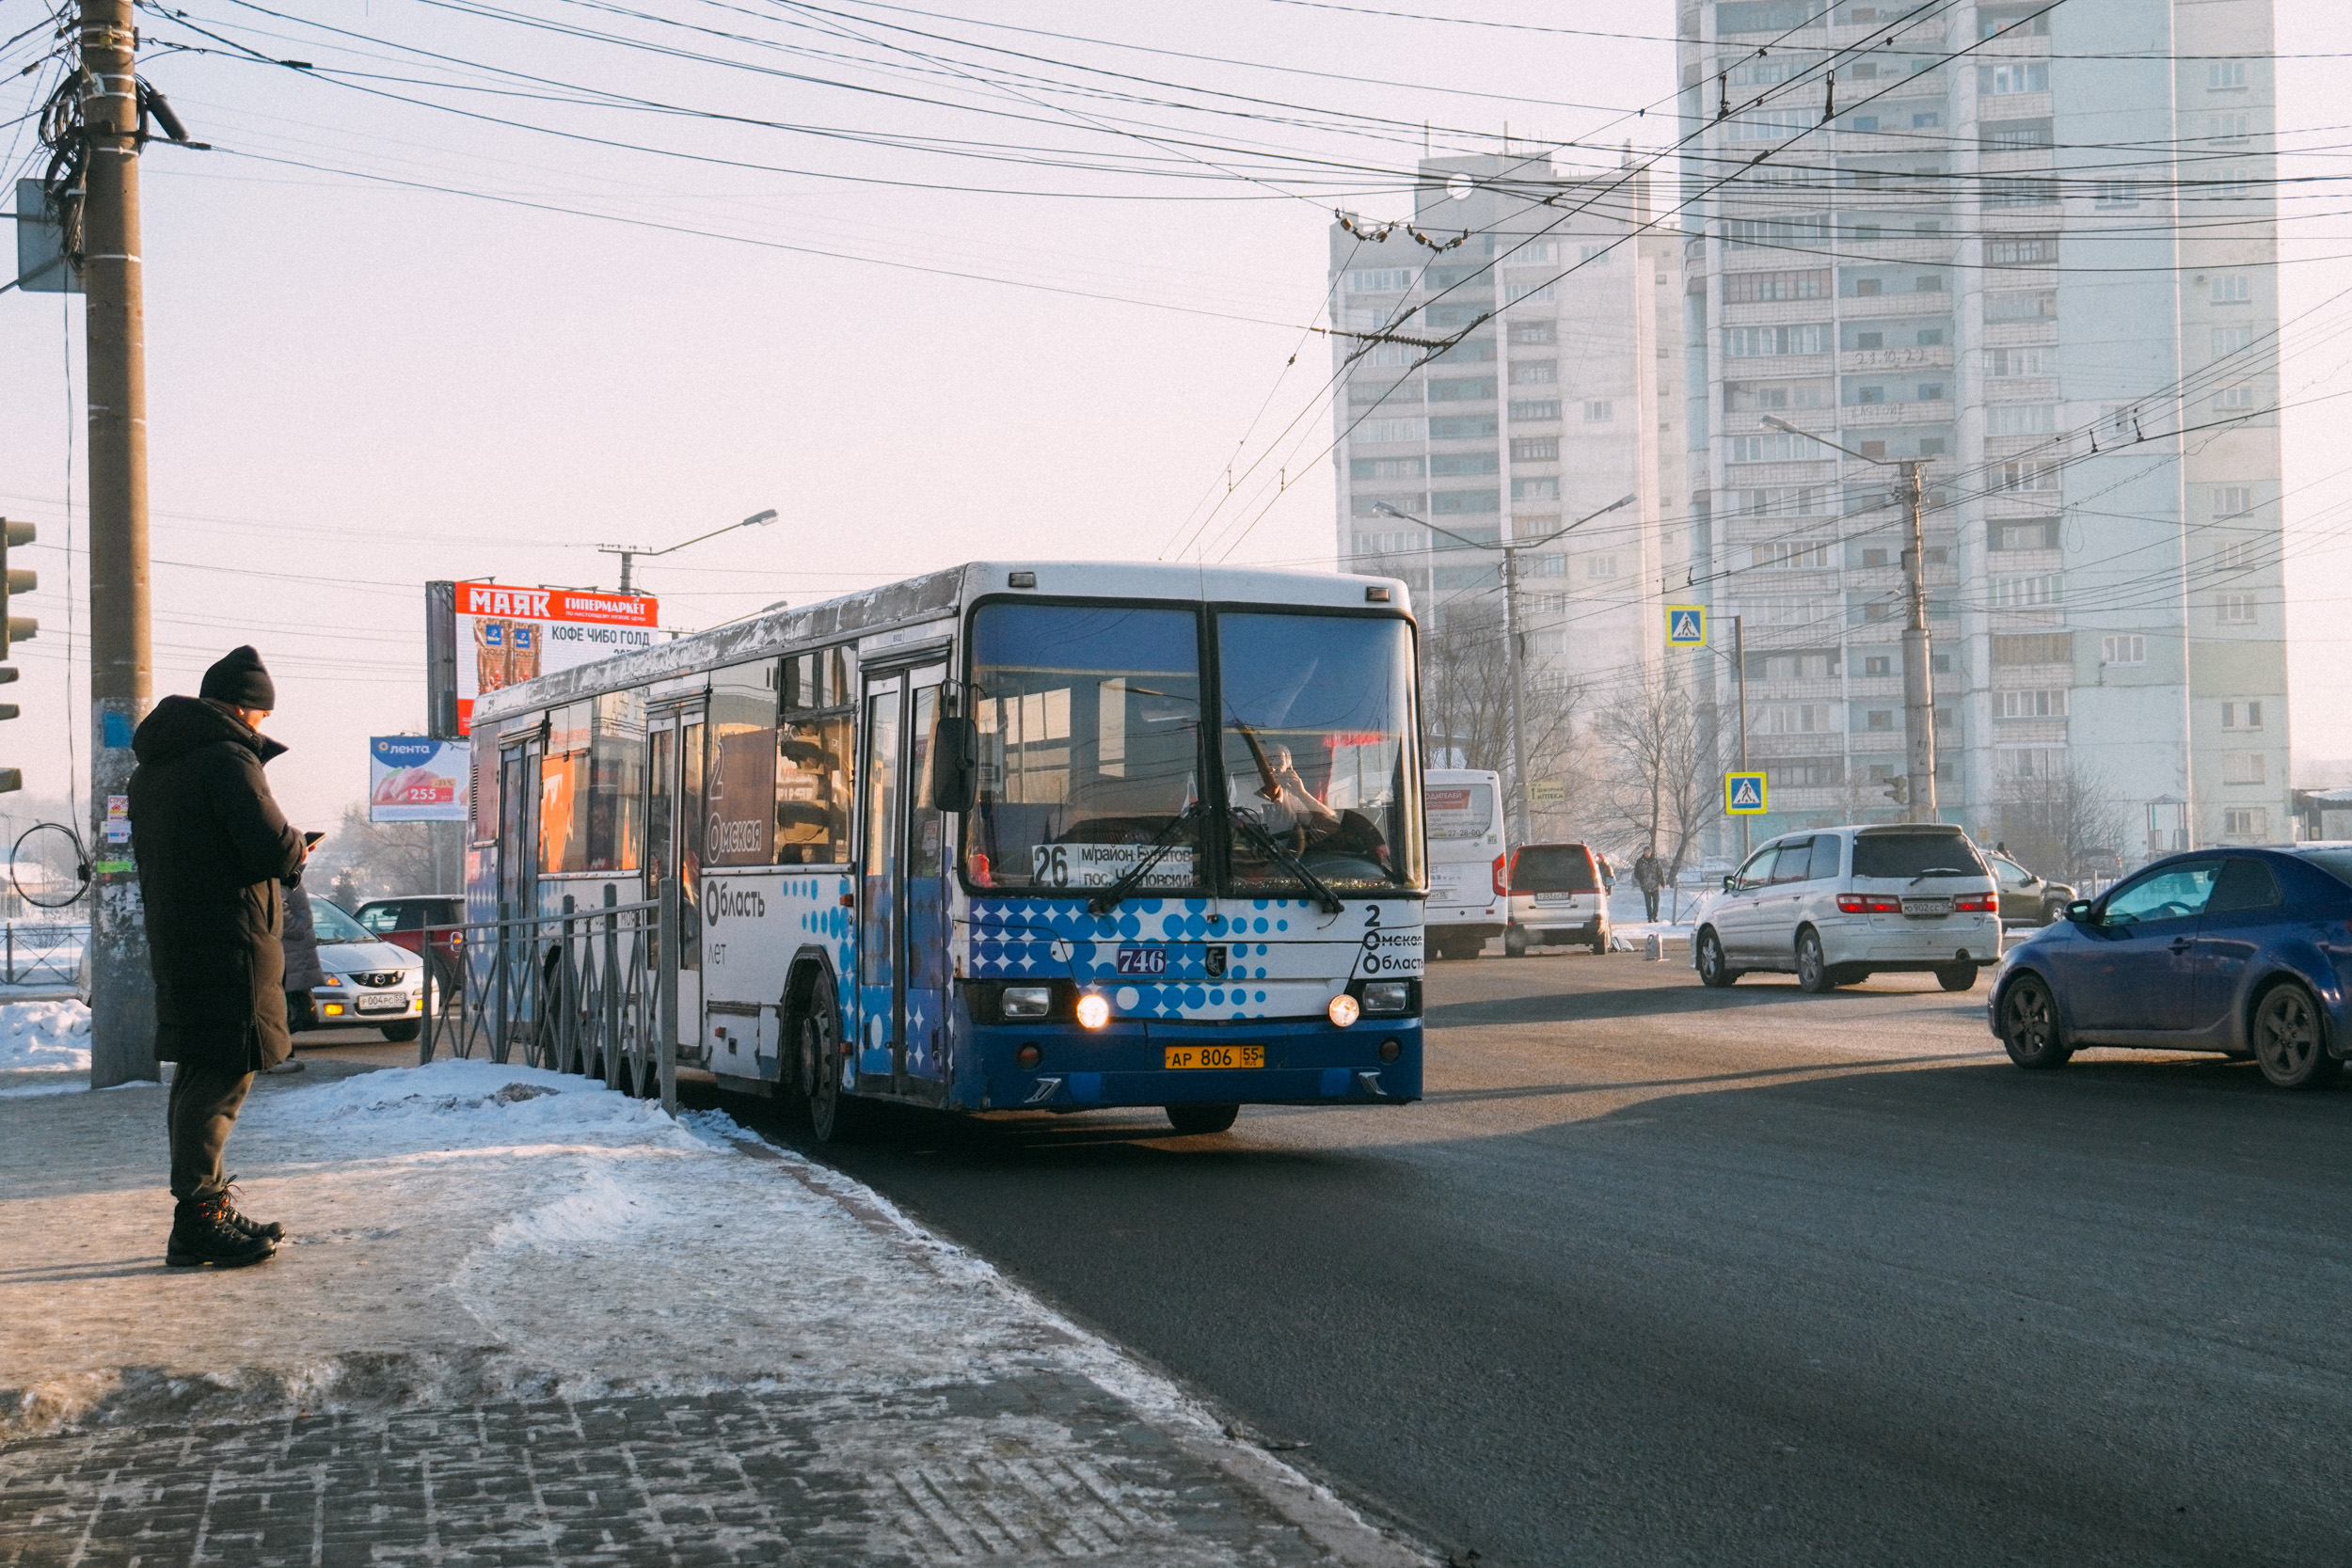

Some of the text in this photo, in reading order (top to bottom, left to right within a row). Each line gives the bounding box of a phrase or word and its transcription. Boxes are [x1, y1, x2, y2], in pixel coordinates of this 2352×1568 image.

[470, 590, 551, 617] МАЯК
[564, 596, 645, 615] ГИПЕРМАРКЕТ
[551, 625, 650, 648] КОФЕ ЧИБО ГОЛД
[484, 648, 506, 657] GOLD
[389, 745, 431, 754] лента
[708, 739, 724, 800] 2
[410, 788, 437, 800] 255
[1425, 791, 1462, 800] ОДИТЕЛЕЙ
[707, 812, 762, 864] Омская
[1035, 846, 1069, 888] 26
[706, 880, 765, 927] Область
[1364, 904, 1380, 927] 2
[1362, 931, 1422, 951] Омская
[707, 943, 726, 965] лет
[1119, 950, 1165, 974] 746
[1200, 1049, 1232, 1066] 806
[1242, 1047, 1260, 1061] 55
